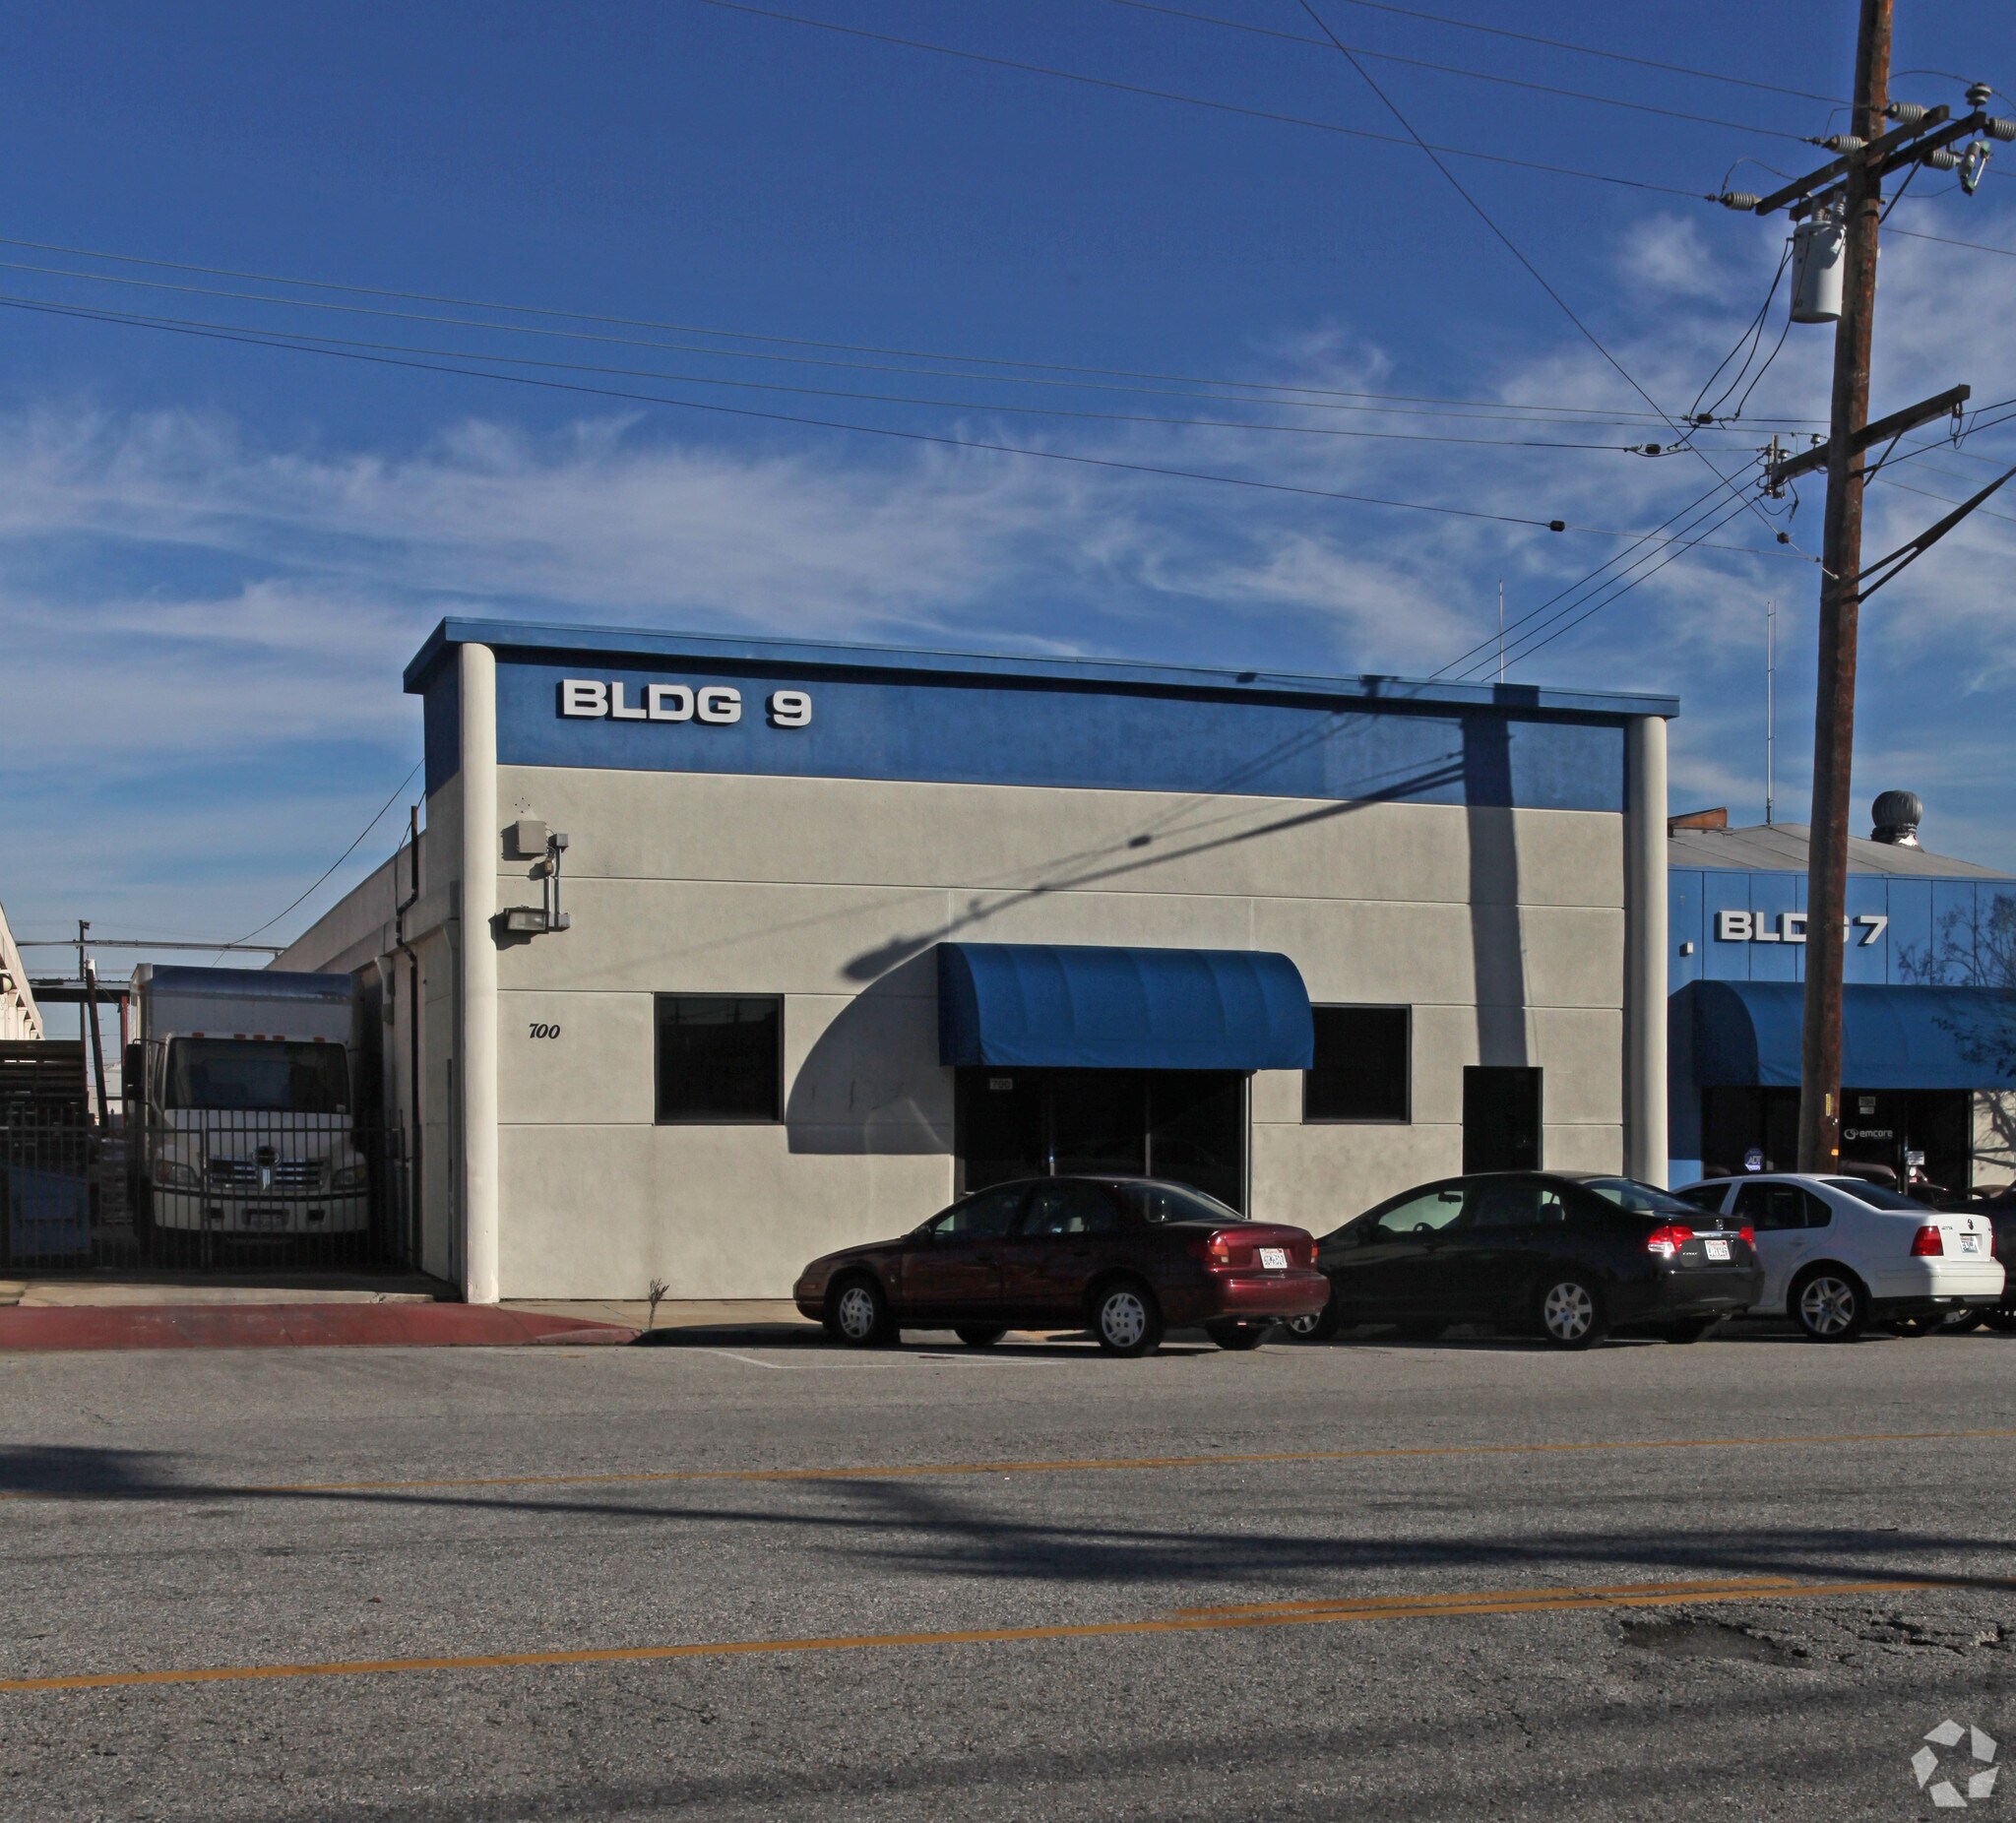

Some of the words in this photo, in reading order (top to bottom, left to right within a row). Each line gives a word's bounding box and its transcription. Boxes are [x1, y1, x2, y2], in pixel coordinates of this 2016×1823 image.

[563, 679, 741, 723] BLDG
[773, 690, 812, 726] 9
[1720, 911, 1850, 943] BLD
[1859, 915, 1888, 944] 7
[529, 1023, 561, 1039] 700
[1859, 1129, 1893, 1138] emcore
